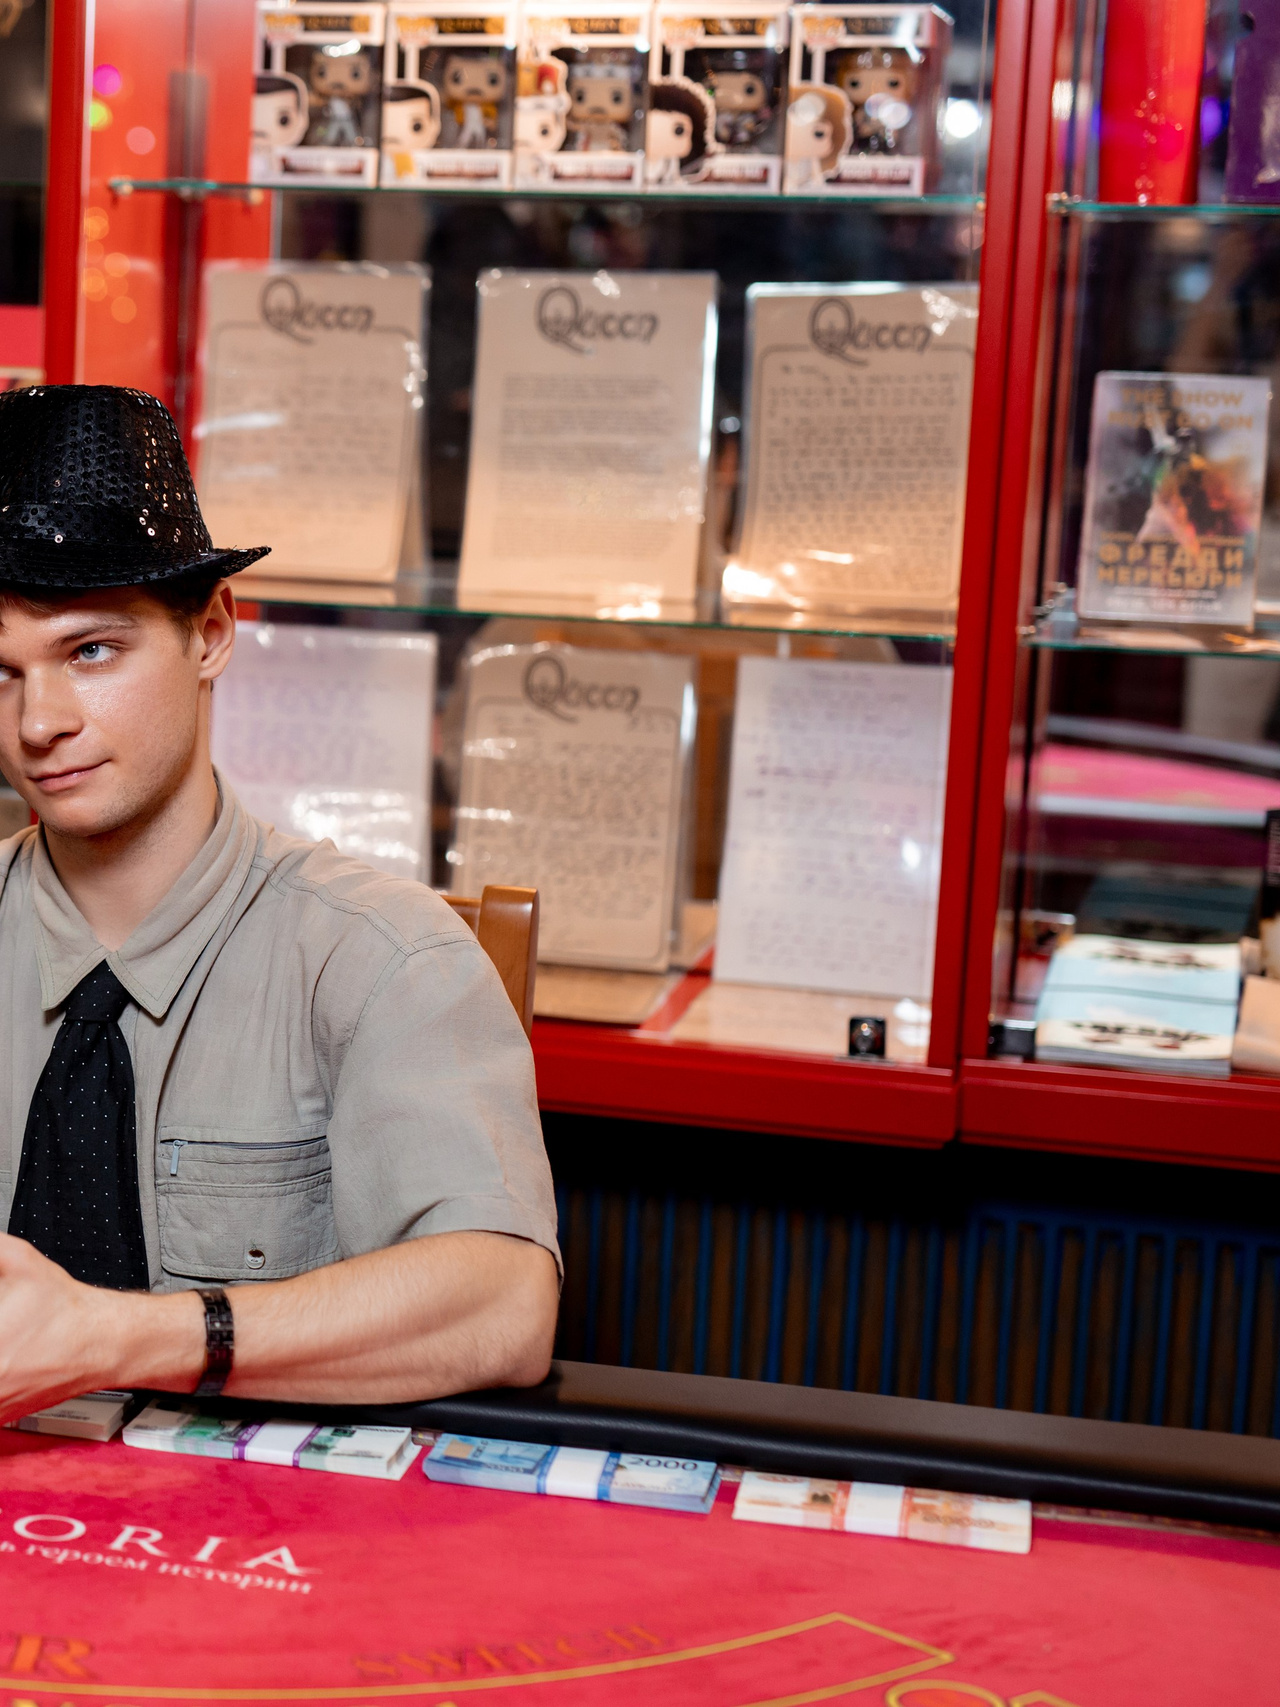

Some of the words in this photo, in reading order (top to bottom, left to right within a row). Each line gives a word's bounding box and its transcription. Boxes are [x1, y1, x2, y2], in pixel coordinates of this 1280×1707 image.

[1099, 542, 1244, 569] ФРЕДДИ
[1097, 565, 1243, 590] МЕРКЬЮРИ
[628, 1455, 699, 1472] 2000
[24, 1540, 148, 1573] героем
[157, 1561, 313, 1596] истории
[352, 1622, 667, 1682] SWITCH
